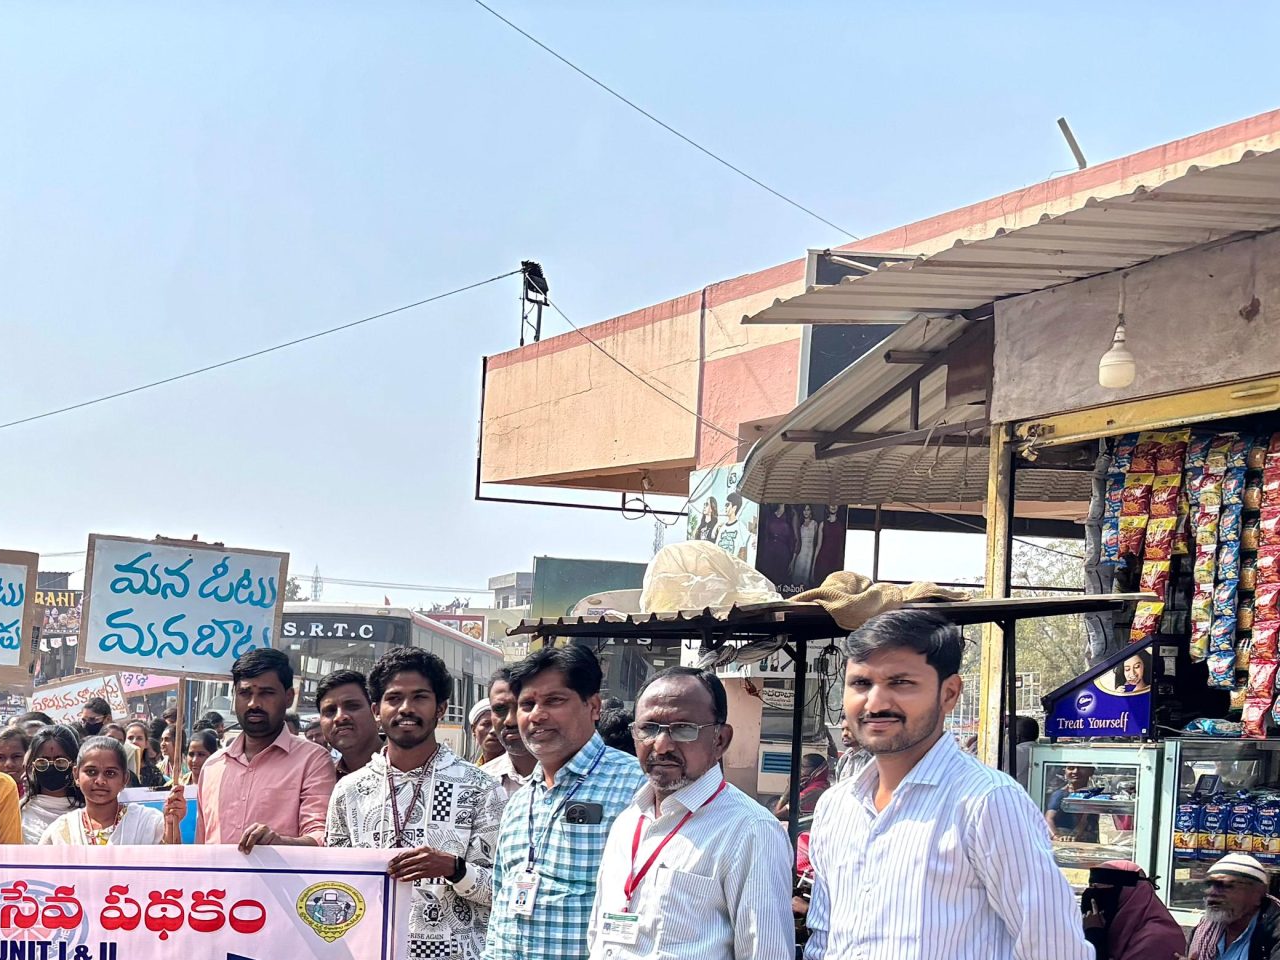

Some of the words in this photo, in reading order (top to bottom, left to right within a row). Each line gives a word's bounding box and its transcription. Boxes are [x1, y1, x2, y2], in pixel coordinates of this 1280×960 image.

[110, 551, 193, 599] మన
[1057, 717, 1084, 729] Treat
[1088, 711, 1129, 732] Yourself
[0, 880, 84, 929] సేవ
[100, 884, 266, 940] పథకం
